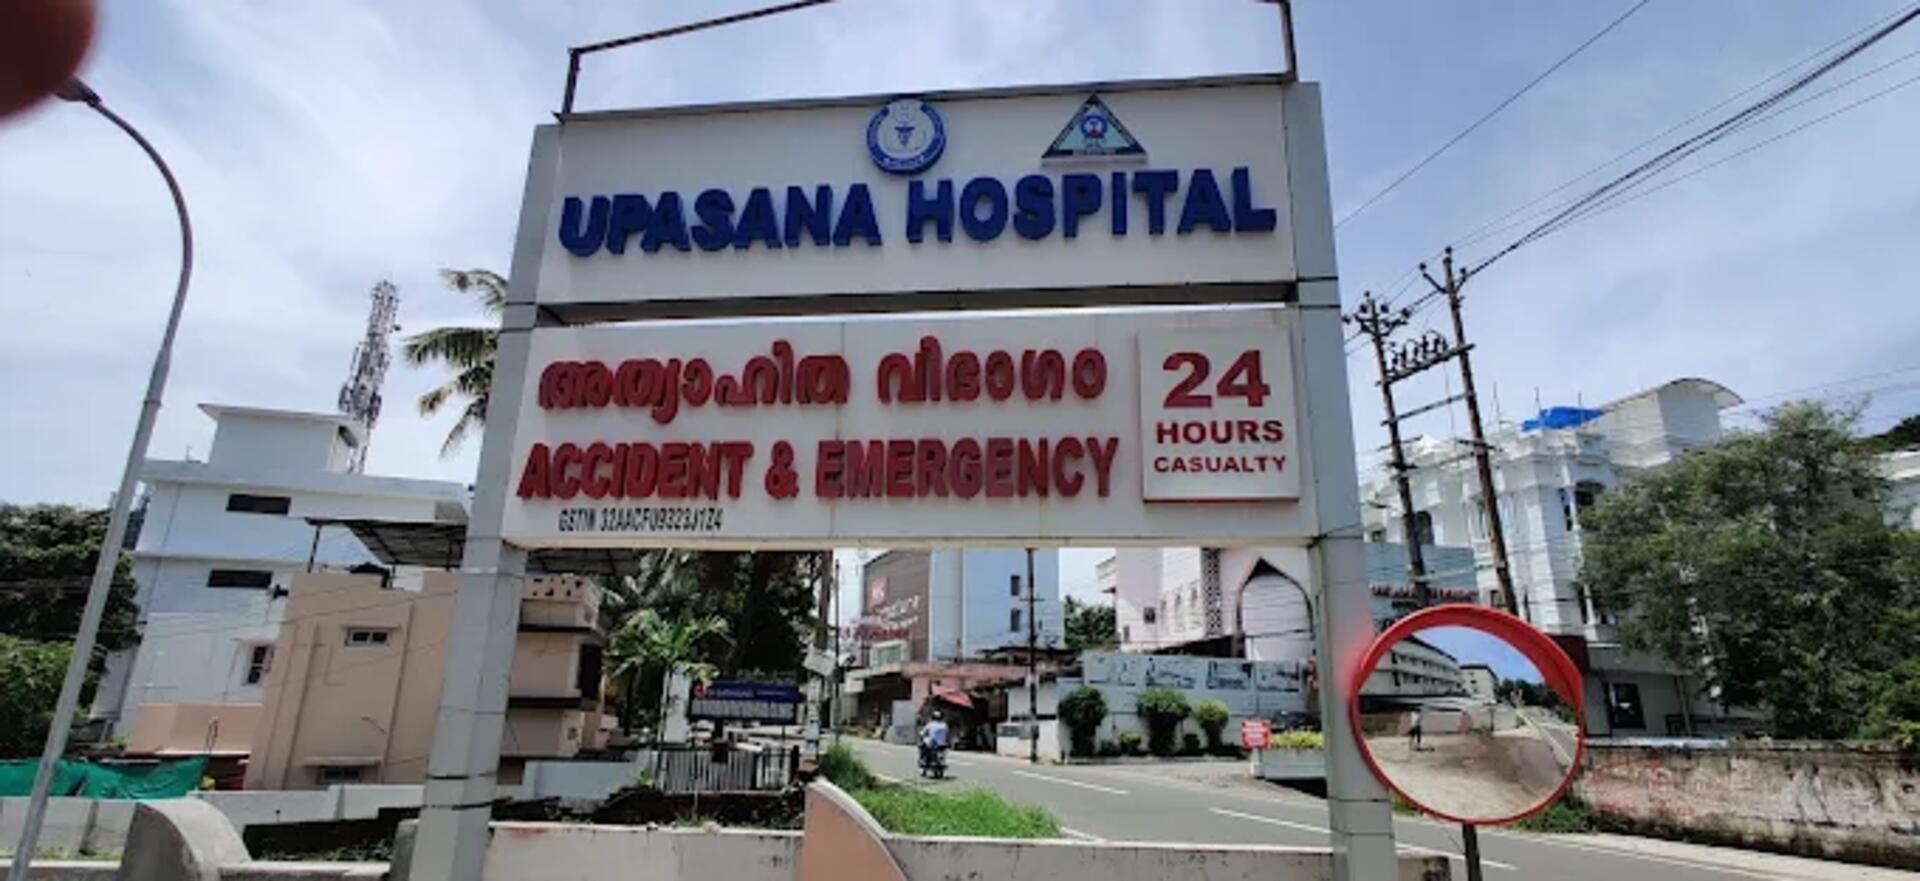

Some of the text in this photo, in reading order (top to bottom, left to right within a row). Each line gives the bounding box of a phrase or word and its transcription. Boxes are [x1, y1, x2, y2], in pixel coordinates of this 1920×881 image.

[558, 168, 1277, 256] UPASANA HOSPITAL
[539, 336, 1108, 424] അത്യാഹിത വിഭാഗം
[1162, 350, 1270, 407] 24
[1154, 420, 1284, 446] HOURS
[517, 437, 1120, 501] ACCIDENT & EMERGENCY
[1153, 455, 1288, 474] CASUALTY
